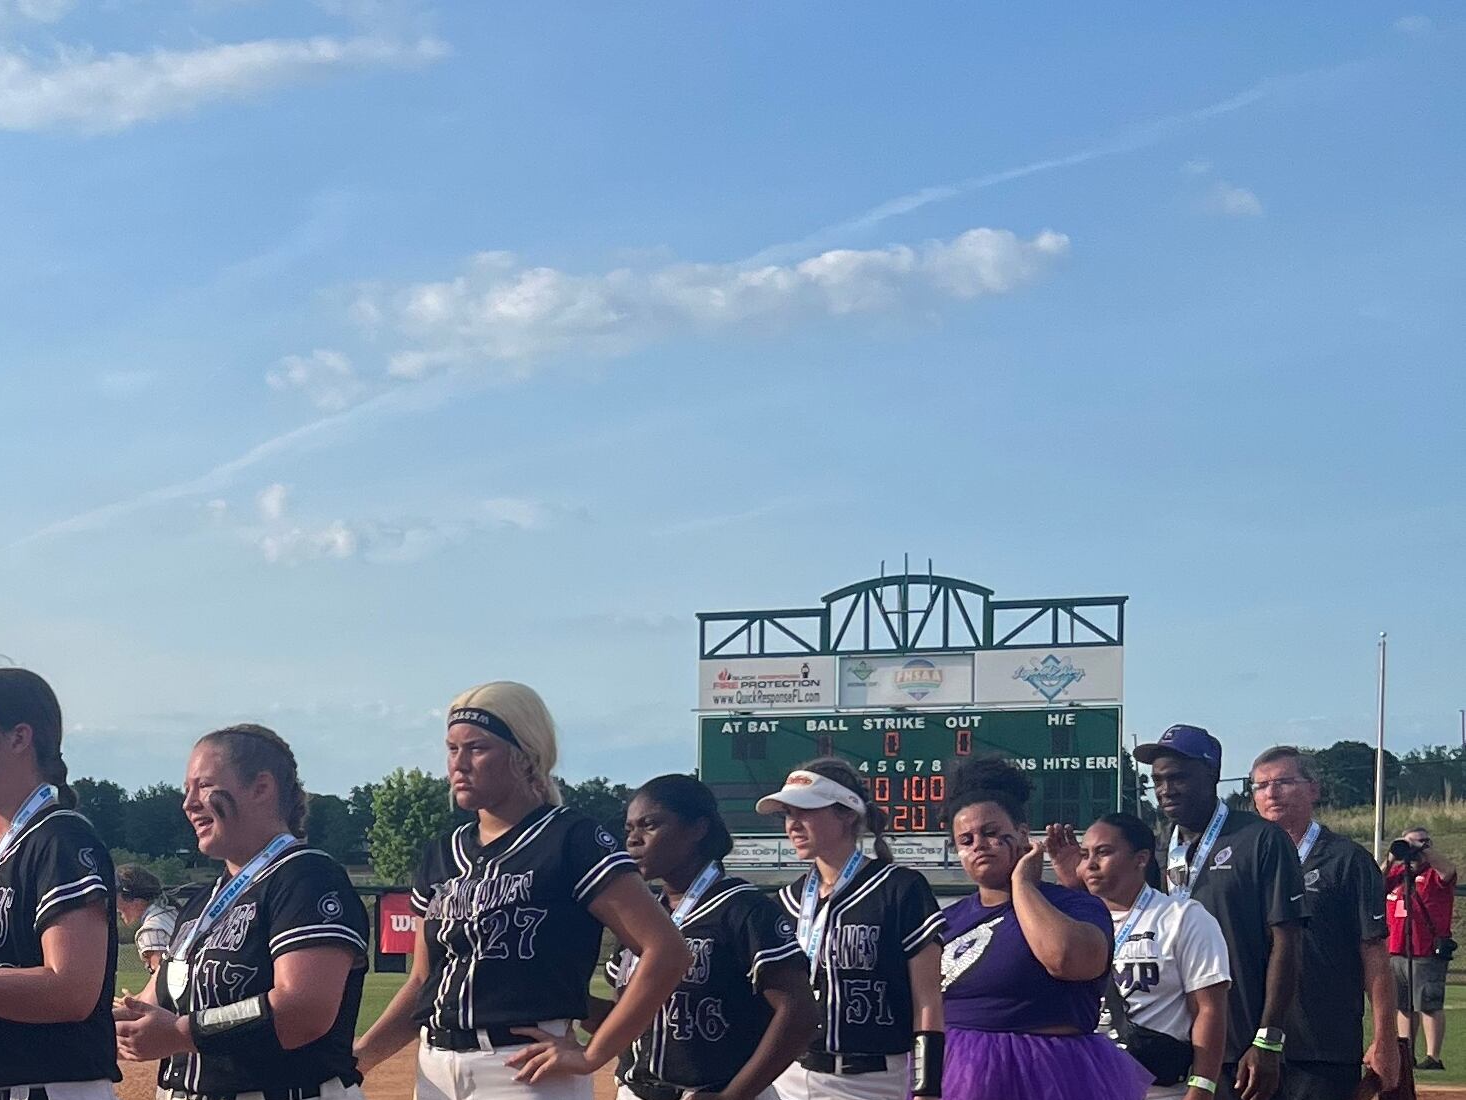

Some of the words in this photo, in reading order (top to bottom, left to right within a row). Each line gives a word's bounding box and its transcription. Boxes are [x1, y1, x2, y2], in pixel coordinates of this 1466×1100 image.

[895, 669, 943, 683] FHSAA
[713, 681, 739, 690] FIRE
[740, 680, 821, 689] PROTECTION
[722, 722, 742, 733] AT
[748, 720, 779, 733] BAT
[806, 719, 848, 731] BALL
[862, 717, 925, 730] STRIKE
[945, 716, 982, 728] OUT
[1047, 713, 1075, 726] H/E
[956, 730, 971, 755] 0
[1043, 757, 1080, 770] HITS
[1085, 756, 1118, 769] ERR
[209, 874, 250, 919] SOFTBALL
[479, 906, 548, 960] 27
[203, 960, 259, 1010] 17
[844, 979, 895, 1026] 51
[666, 991, 730, 1041] 46
